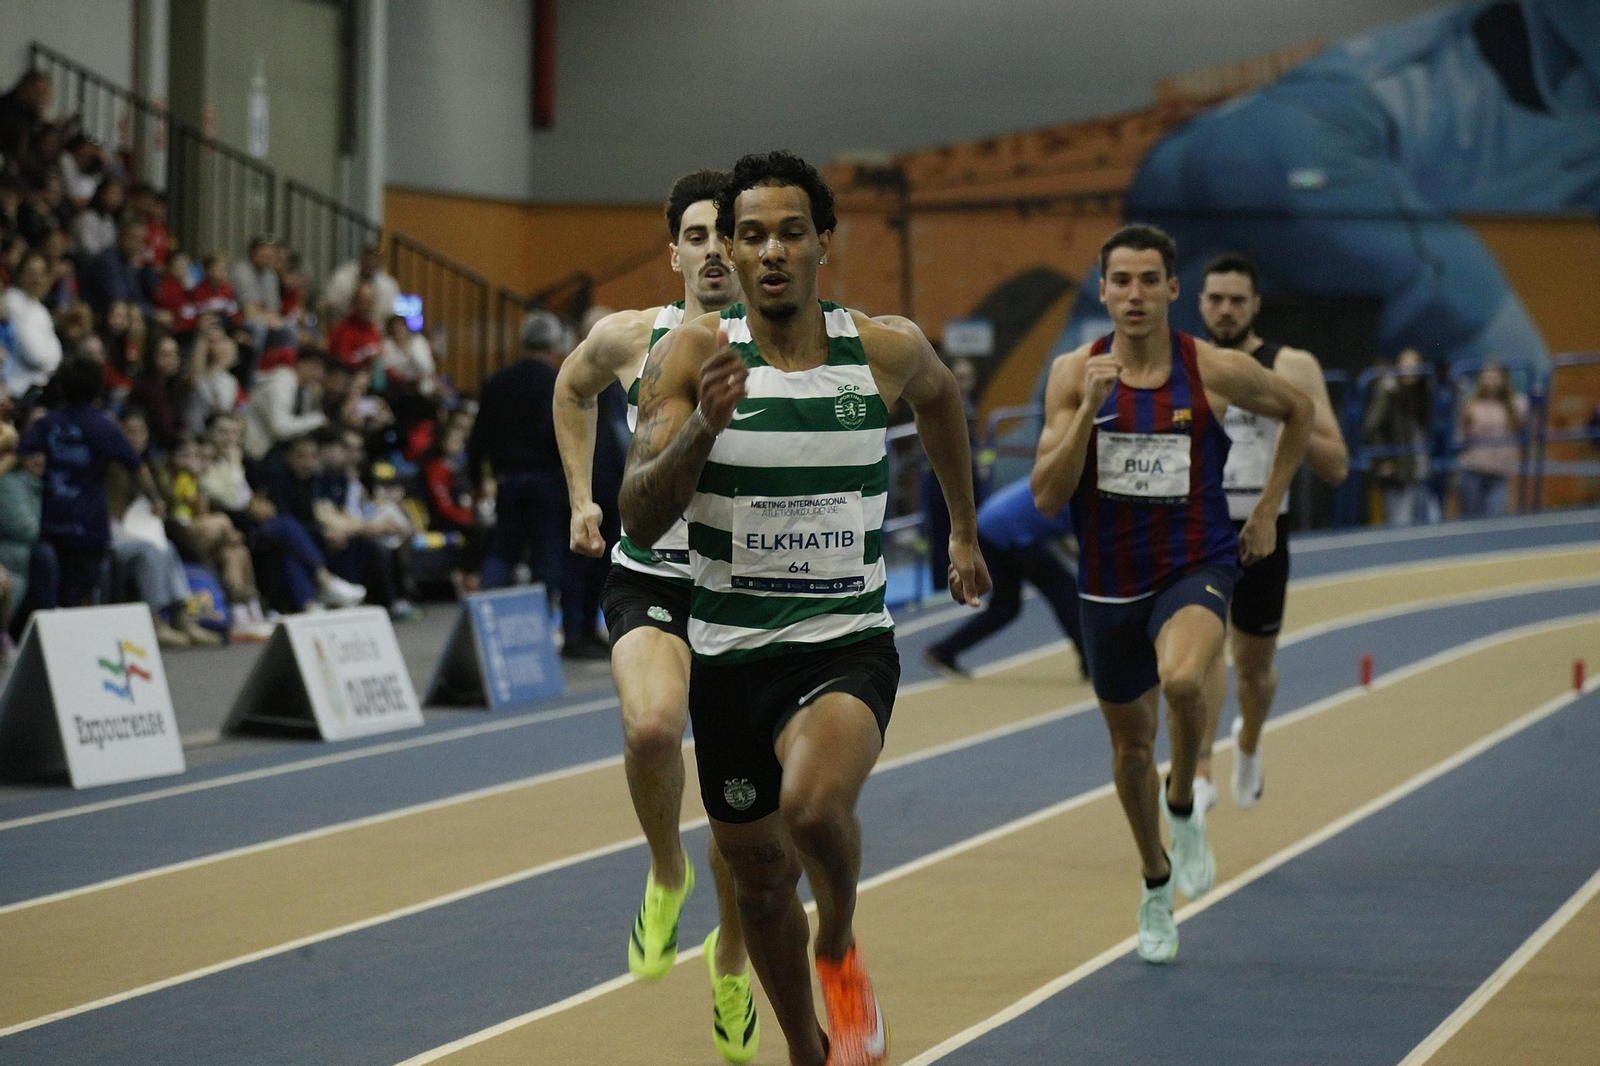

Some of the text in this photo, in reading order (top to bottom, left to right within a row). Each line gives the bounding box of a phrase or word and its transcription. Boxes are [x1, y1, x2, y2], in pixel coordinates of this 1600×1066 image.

[837, 384, 860, 393] SCP
[1125, 458, 1164, 474] BUA
[750, 496, 848, 509] MEETING INTERNACIONAL
[746, 530, 855, 551] ELKHATIB
[788, 561, 811, 574] 64
[73, 710, 168, 753] Expourense
